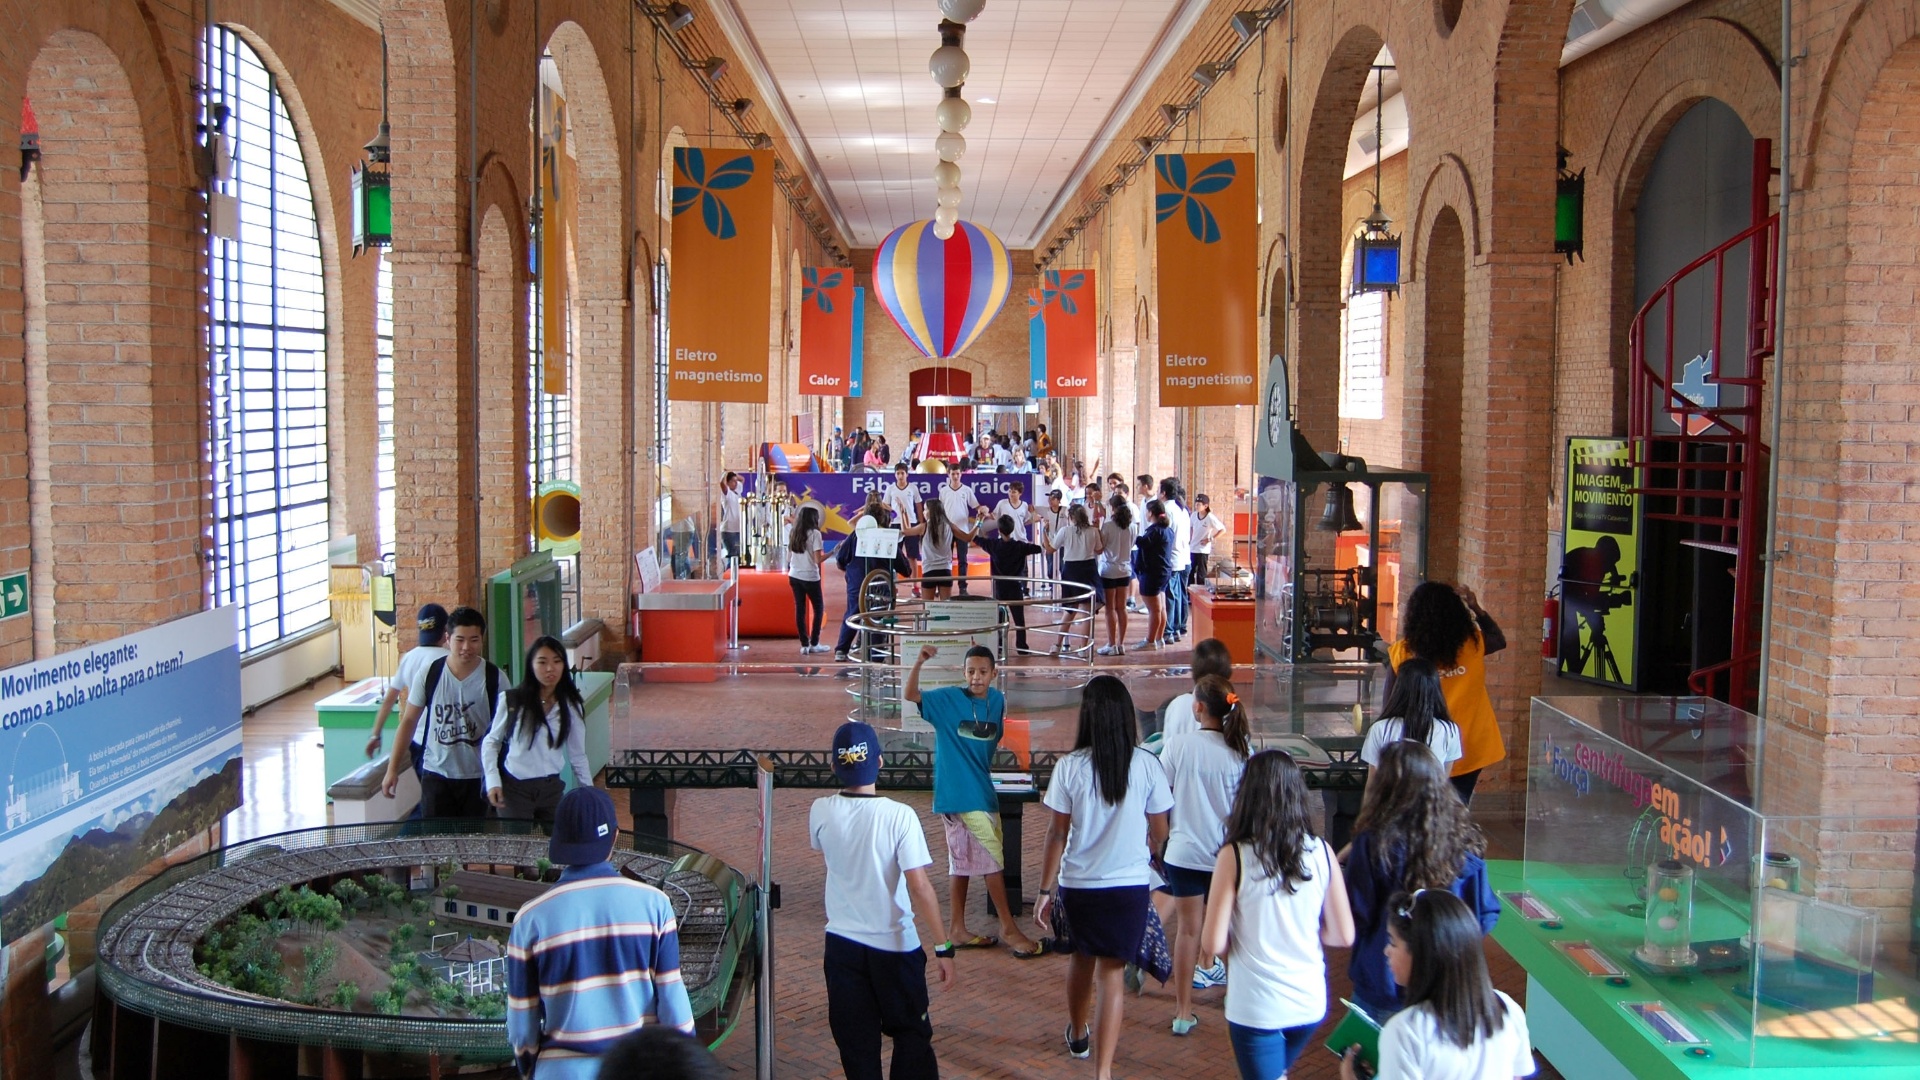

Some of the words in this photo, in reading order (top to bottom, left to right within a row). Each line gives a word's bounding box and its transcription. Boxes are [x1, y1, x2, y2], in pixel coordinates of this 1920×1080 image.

[676, 348, 717, 362] Eletro
[1166, 354, 1207, 367] Eletro
[675, 370, 763, 384] magnetismo
[808, 374, 840, 386] Calor
[1056, 376, 1088, 387] Calor
[1166, 373, 1253, 389] magnetismo
[852, 477, 931, 494] Fába
[1576, 474, 1620, 488] IMAGEM
[1575, 490, 1632, 506] MOVIMENTO
[1, 660, 81, 700] Movimento
[83, 643, 138, 675] elegante:
[2, 704, 43, 730] como
[46, 699, 54, 716] a
[56, 685, 86, 712] bola
[88, 676, 118, 701] volta
[120, 668, 144, 696] para
[147, 666, 154, 681] o
[156, 650, 184, 678] trem?
[1554, 746, 1590, 798] Força
[1574, 742, 1652, 808] centrífuga
[1652, 783, 1680, 820] em
[1660, 817, 1712, 868] ação!
